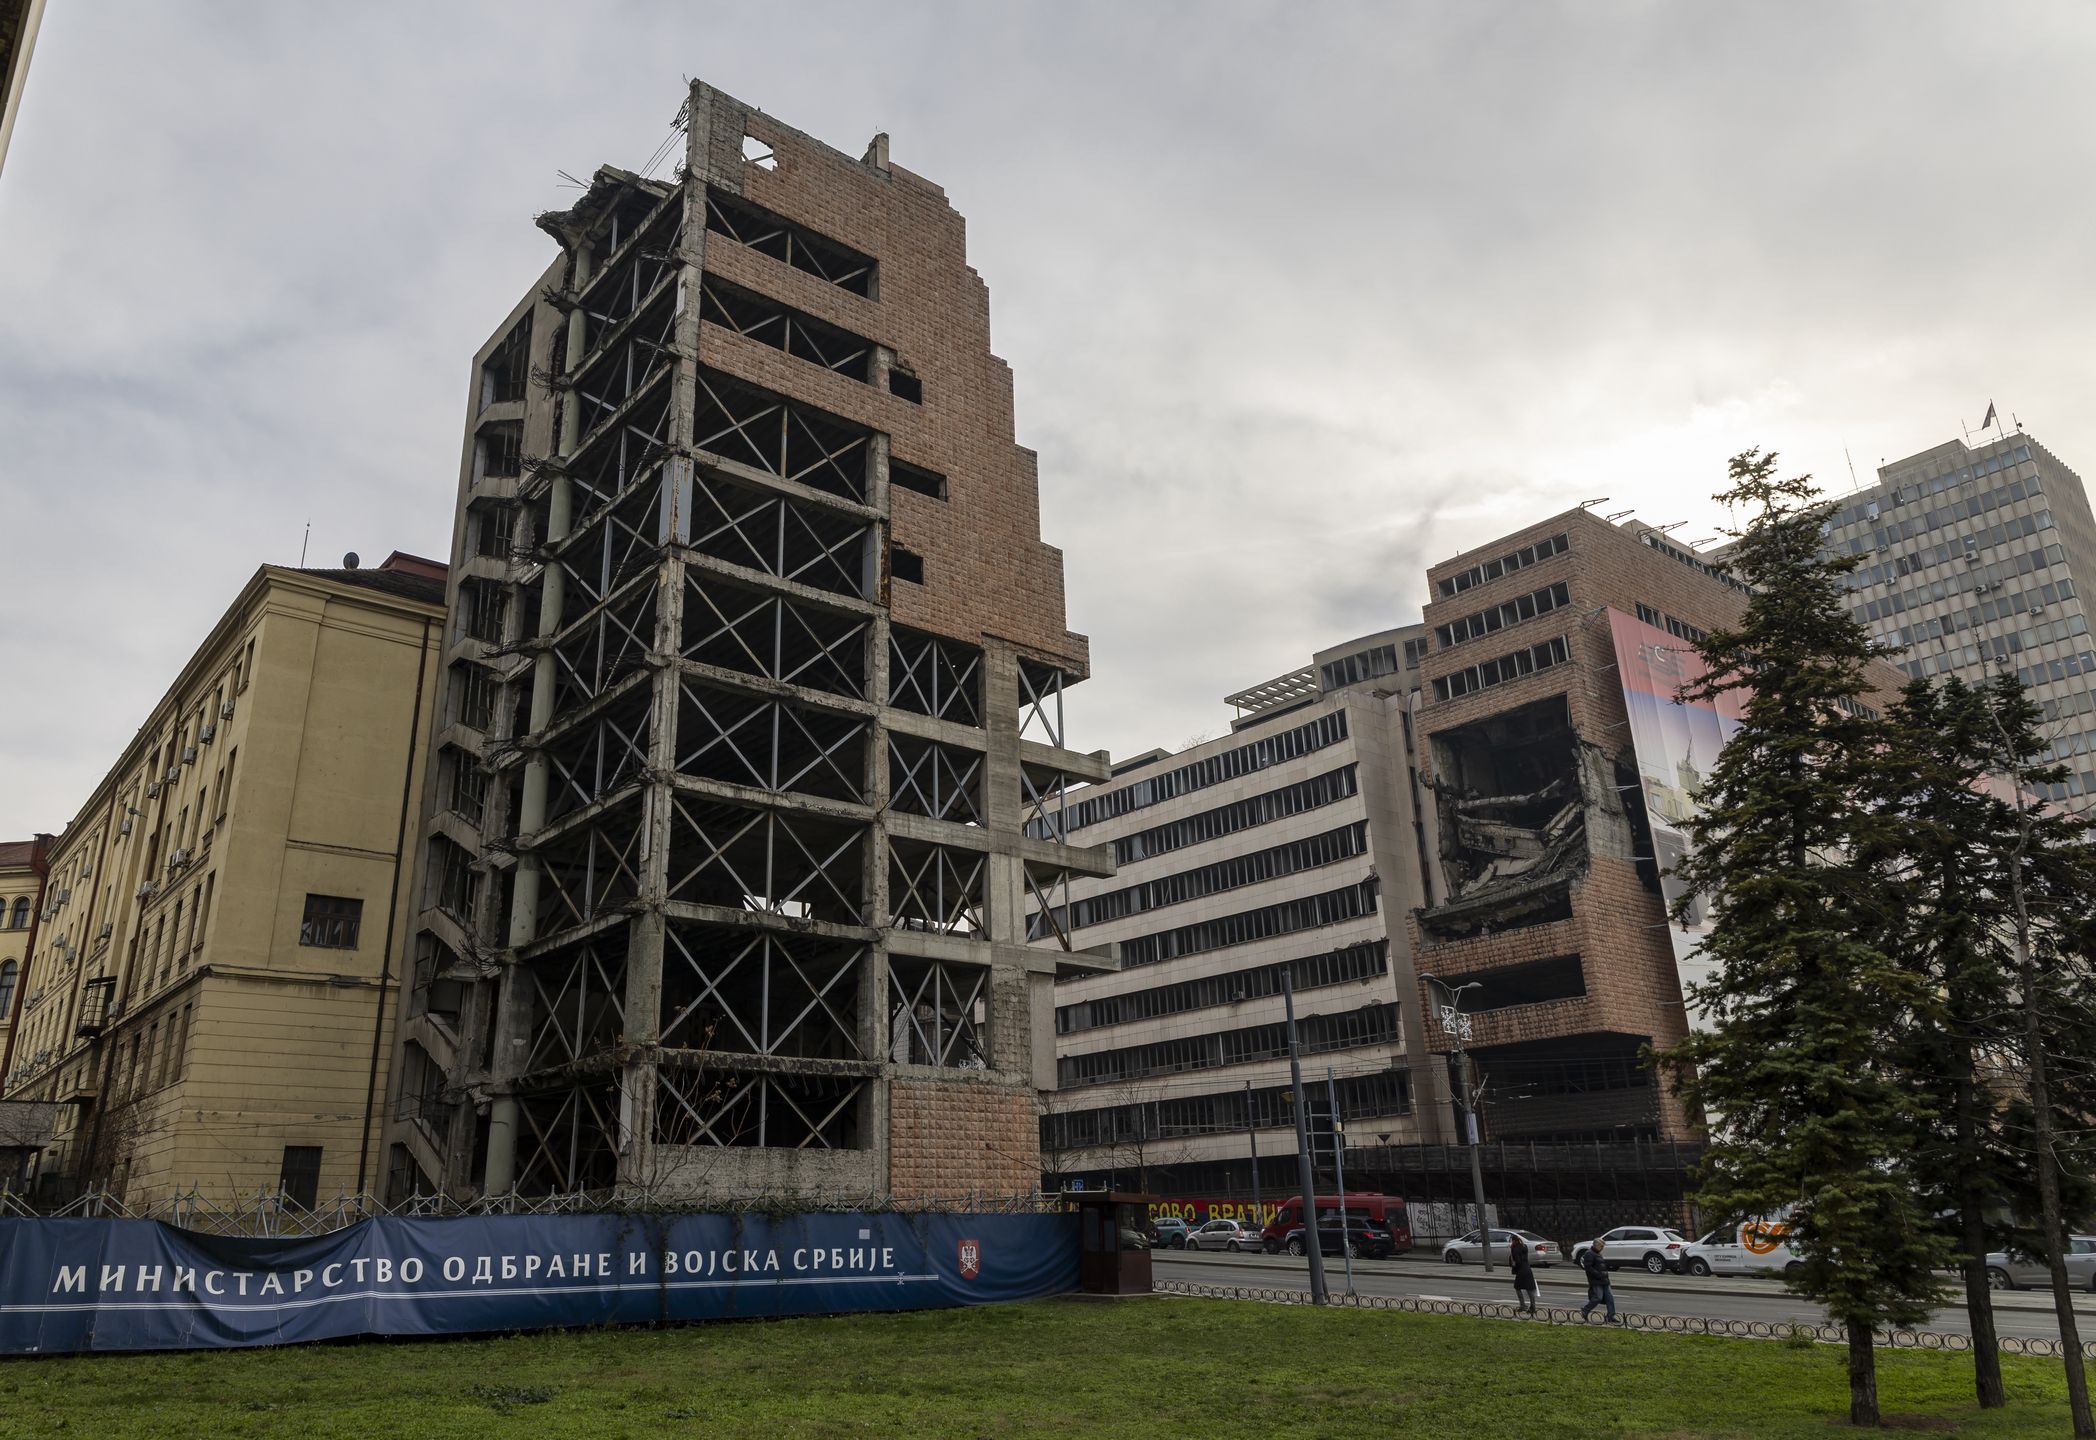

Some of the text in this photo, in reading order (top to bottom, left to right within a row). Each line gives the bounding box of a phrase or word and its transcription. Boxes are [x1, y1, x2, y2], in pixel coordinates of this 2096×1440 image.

[52, 1247, 894, 1296] МИНИСТАРСТВО ОДБРАНЕ И ВОЈСКА СРБИЈЕ
